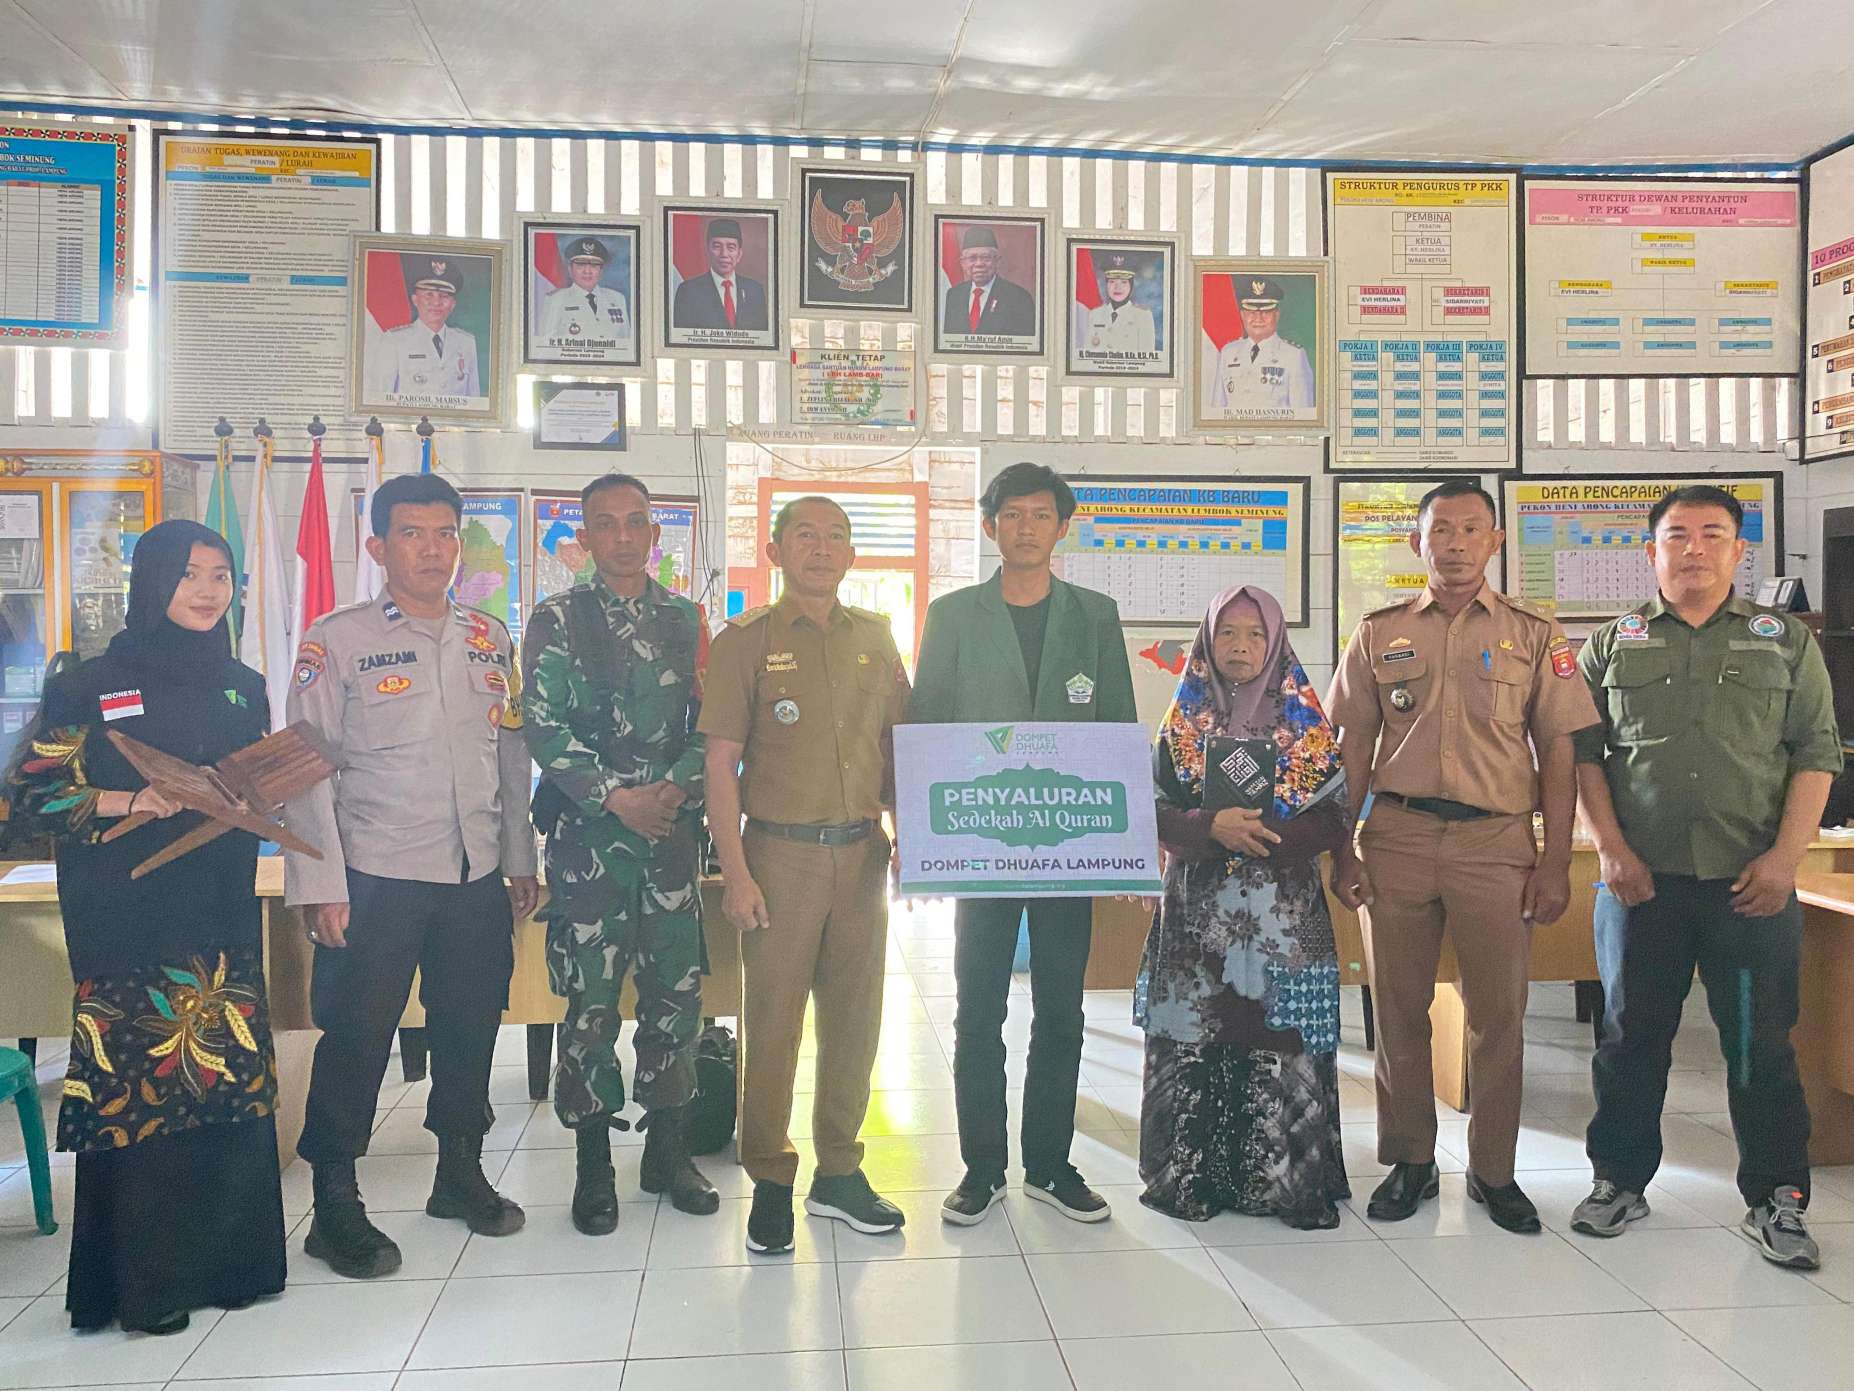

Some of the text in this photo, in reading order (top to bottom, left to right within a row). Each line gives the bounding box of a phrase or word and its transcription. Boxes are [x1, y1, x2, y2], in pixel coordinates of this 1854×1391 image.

[214, 147, 240, 157] TUGAS,
[245, 148, 290, 158] WEWENANG
[293, 150, 310, 158] DAN
[312, 150, 357, 160] KEWAJIBAN
[16, 154, 55, 164] SEMINUNG
[286, 160, 312, 168] LURAH
[1340, 182, 1504, 191] STRUKTUR PENGURUS TP PKK
[1577, 194, 1748, 204] STRUKTUR DEWAN PENYANTUN
[1588, 206, 1604, 214] TP.
[1606, 206, 1630, 214] PKK
[1670, 207, 1736, 215] KELURAHAN
[1406, 212, 1450, 222] PEMBINA
[1816, 254, 1826, 264] 10
[772, 430, 814, 439] PERATIN
[833, 432, 865, 440] RUANG
[1098, 488, 1261, 503] PENCAPAIAN KB BARU
[1542, 486, 1672, 499] DATA PENCAPAIAN
[652, 513, 679, 521] BARAT
[468, 651, 506, 668] POLRI
[99, 689, 141, 701] INDONESIA
[1016, 733, 1057, 742] DOMPET
[1016, 742, 1057, 750] DHUAFA
[944, 787, 1112, 806] PENYALURAN
[947, 810, 1112, 832] Sedekah Al Quran
[921, 858, 1145, 872] DOMPET DHUAFA LAMPUNG
